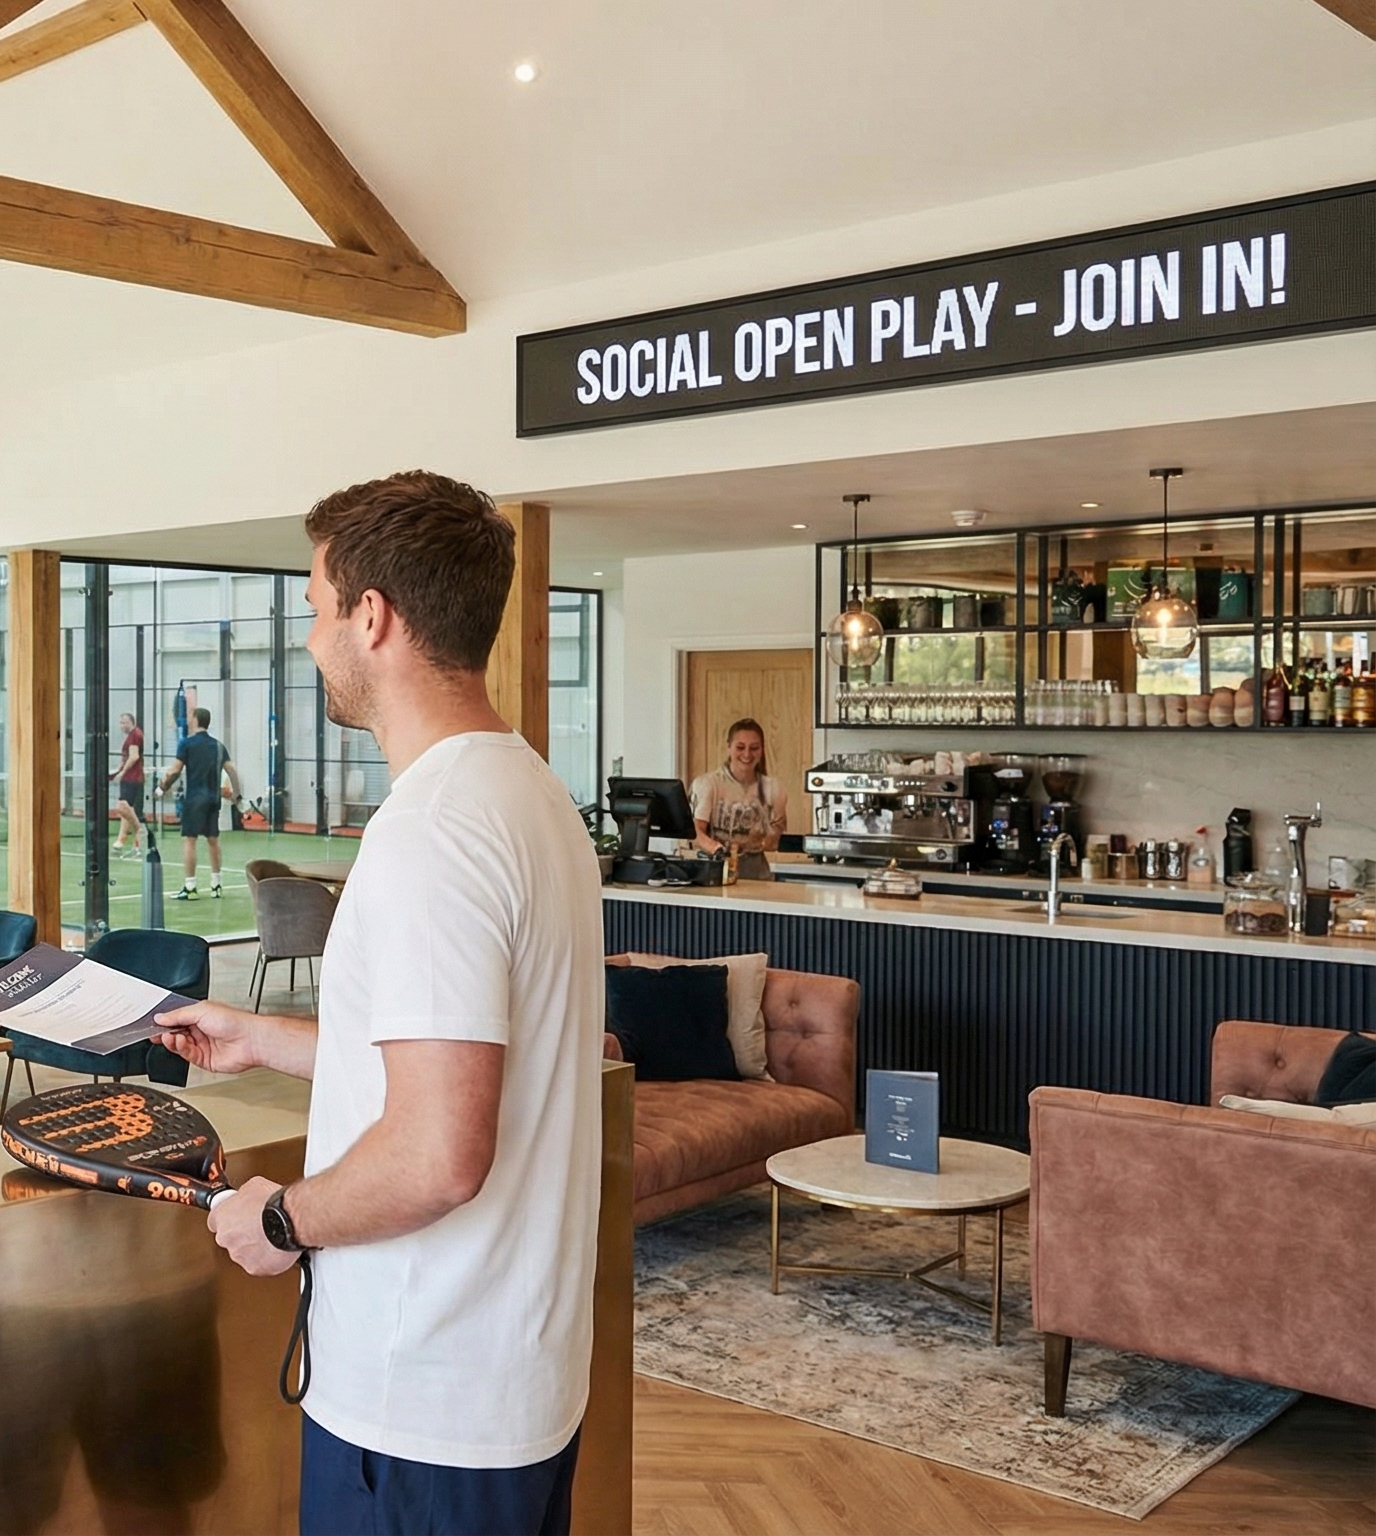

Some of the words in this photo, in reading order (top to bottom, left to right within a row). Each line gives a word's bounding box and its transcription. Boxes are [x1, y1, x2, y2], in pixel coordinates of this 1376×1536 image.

[576, 330, 723, 405] SOCIAL
[734, 306, 854, 382] OPEN
[870, 281, 999, 363] PLAY
[1053, 250, 1180, 337] JOIN
[1202, 232, 1286, 315] IN!
